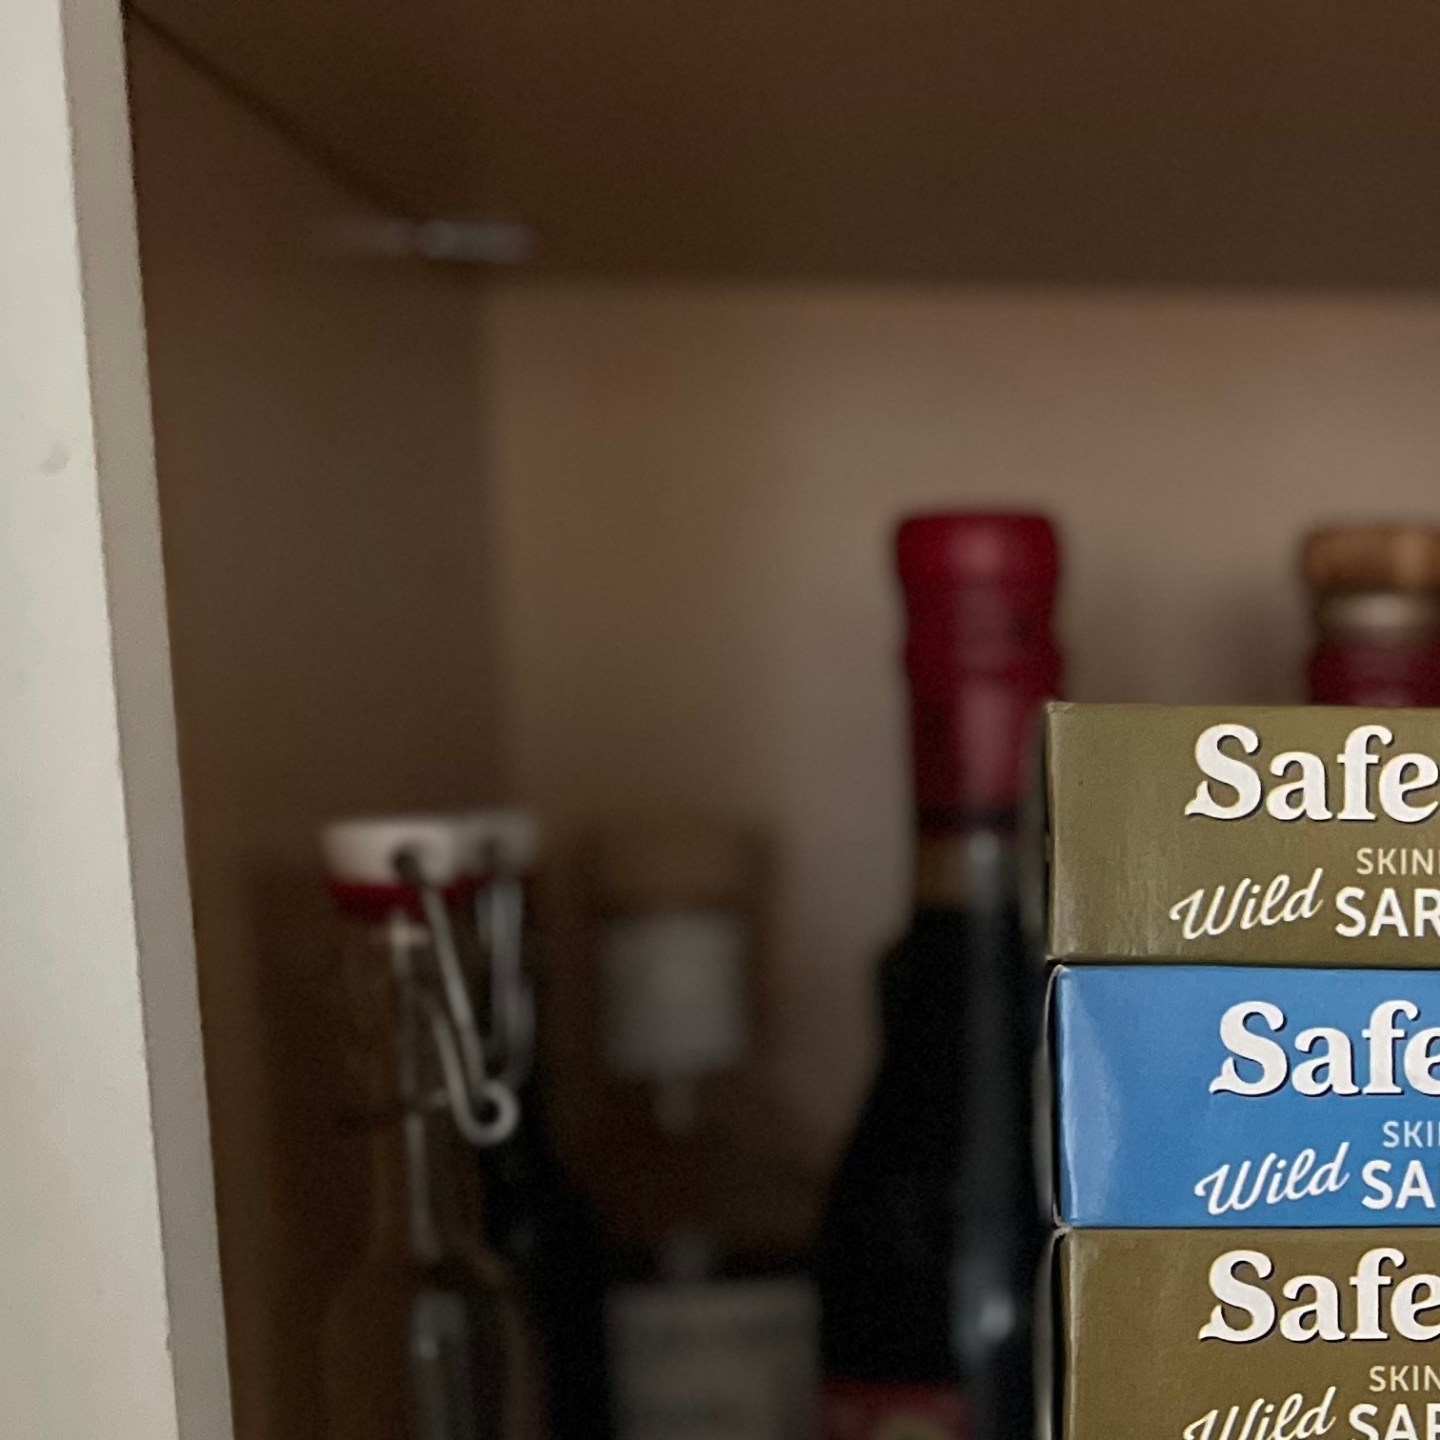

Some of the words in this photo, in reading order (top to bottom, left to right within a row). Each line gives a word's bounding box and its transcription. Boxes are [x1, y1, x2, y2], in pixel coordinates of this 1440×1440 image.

[1184, 723, 1439, 823] Safe
[1169, 867, 1324, 940] Wild
[1194, 1141, 1350, 1215] Wild
